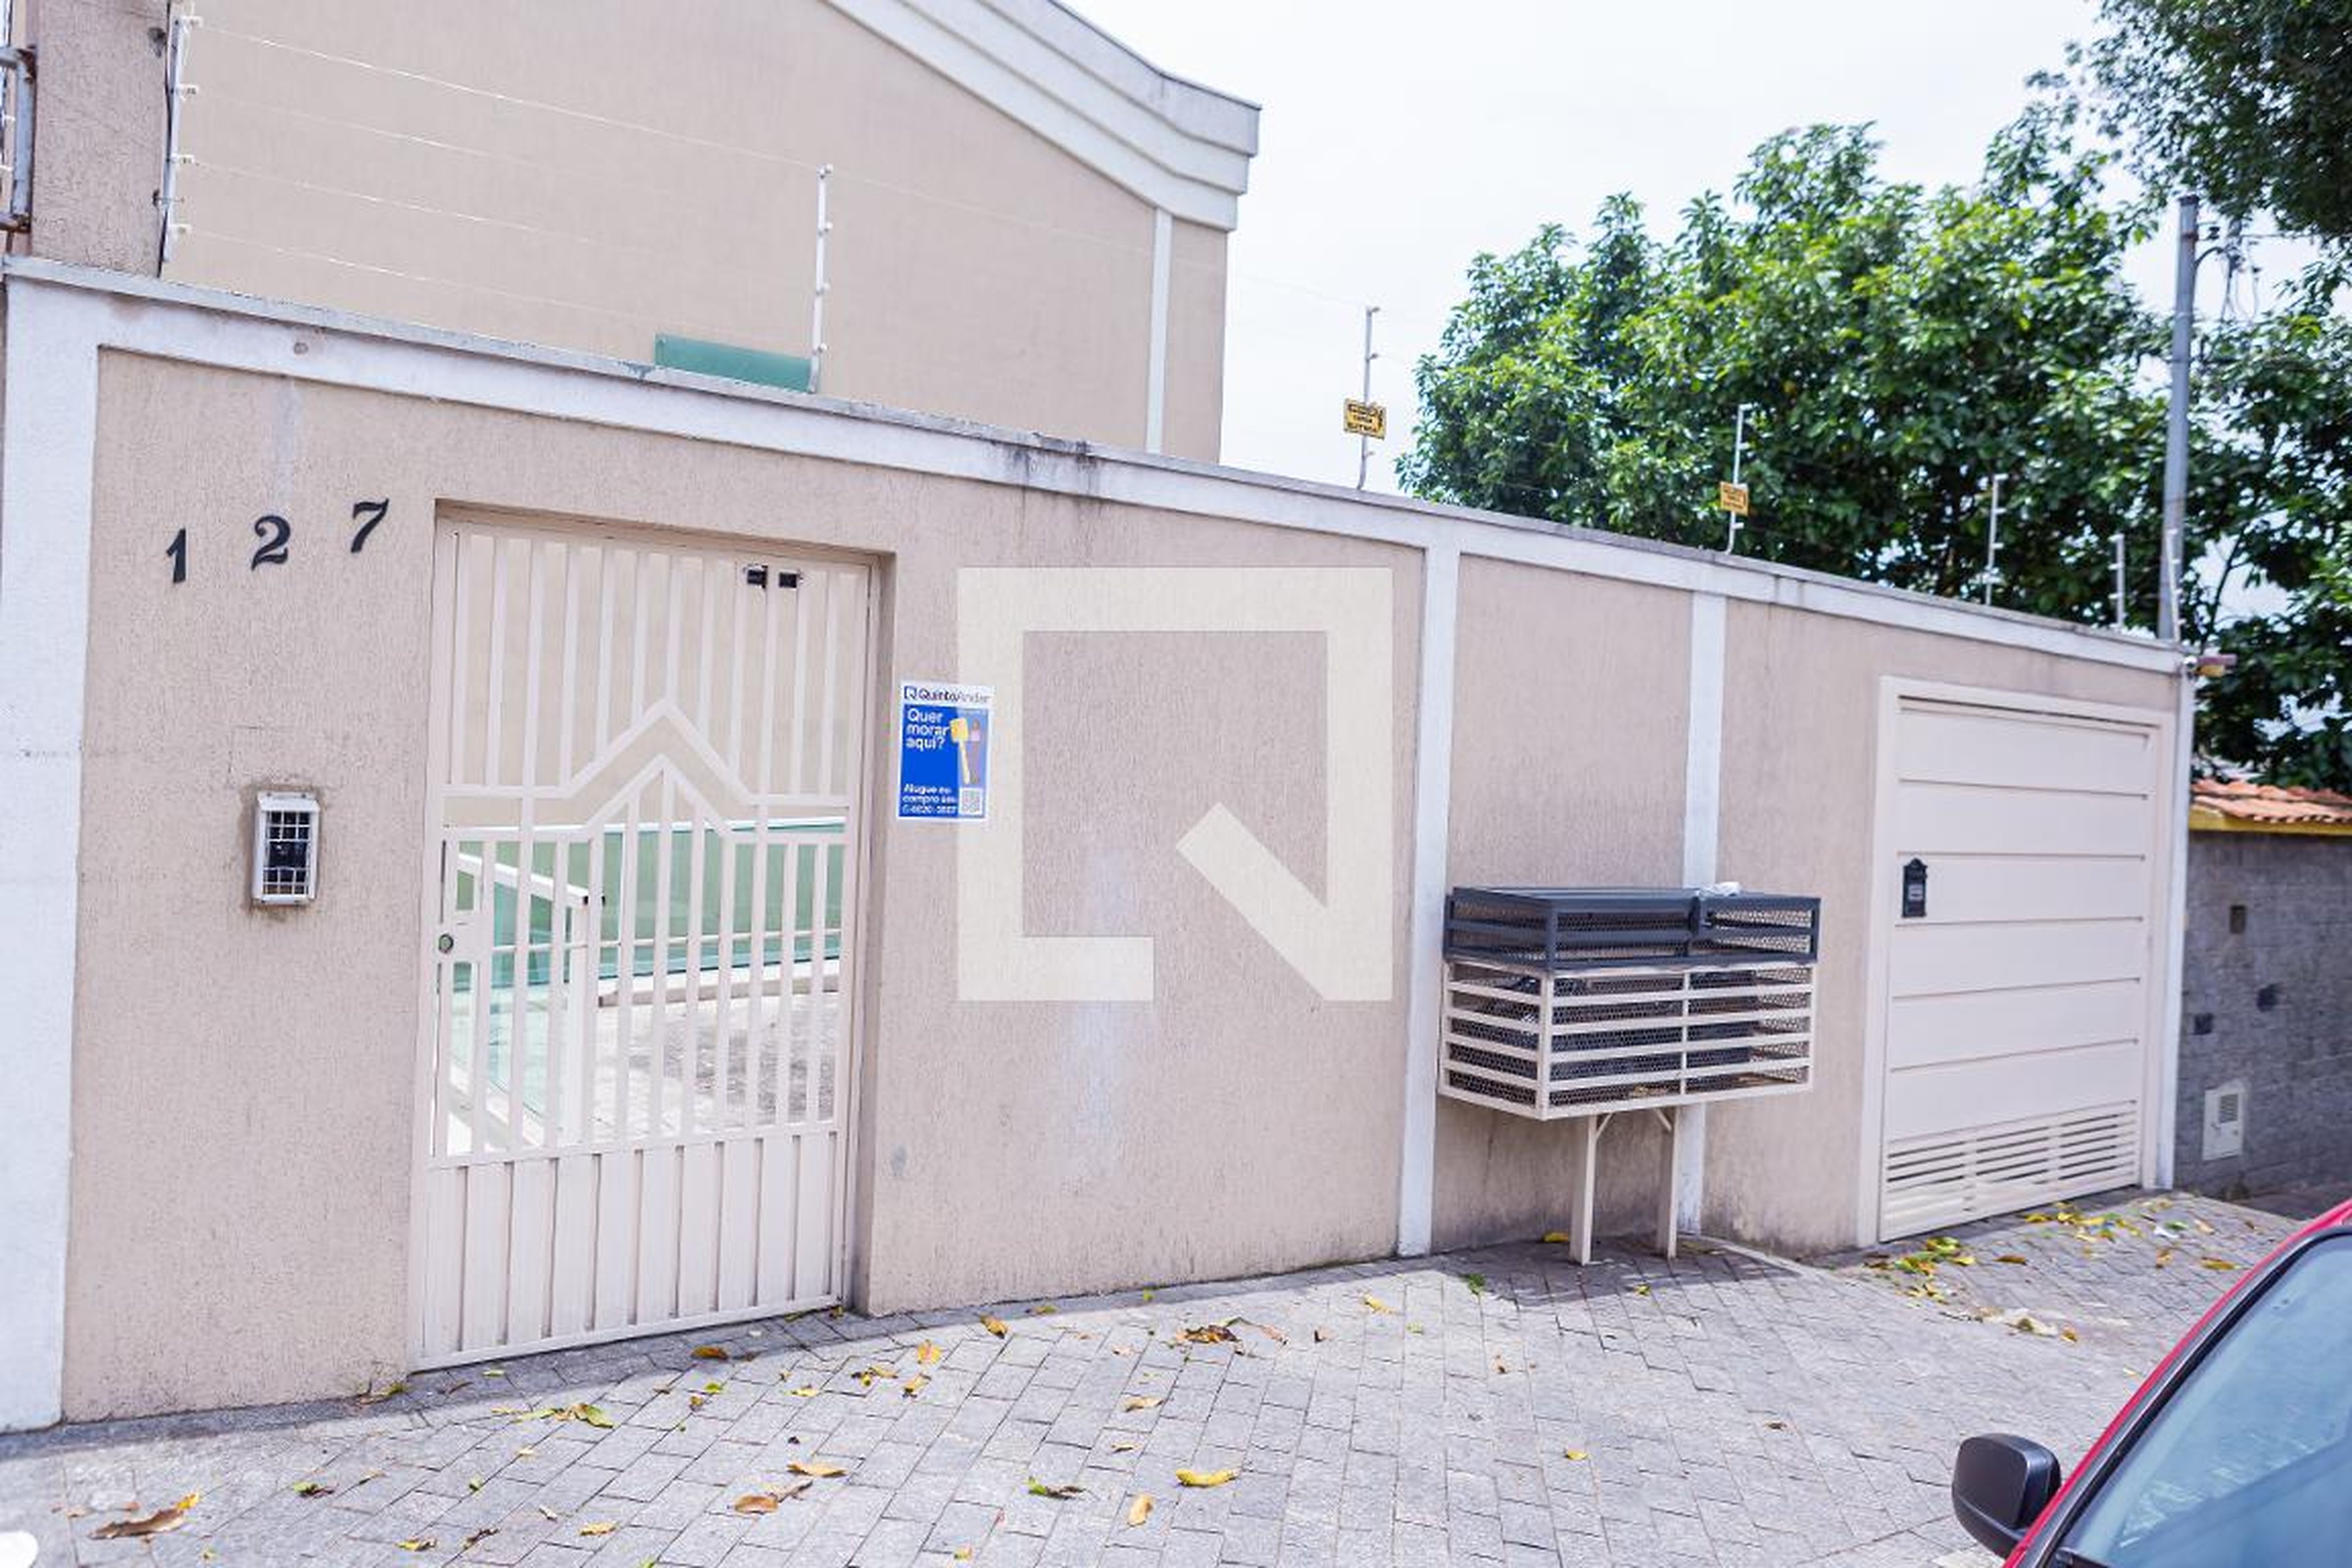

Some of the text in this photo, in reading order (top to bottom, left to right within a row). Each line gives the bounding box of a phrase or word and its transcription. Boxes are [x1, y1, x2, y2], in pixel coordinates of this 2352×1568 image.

[166, 498, 390, 583] 127
[907, 707, 943, 723] Quer
[906, 724, 950, 736] morar
[906, 737, 945, 752] aqui?
